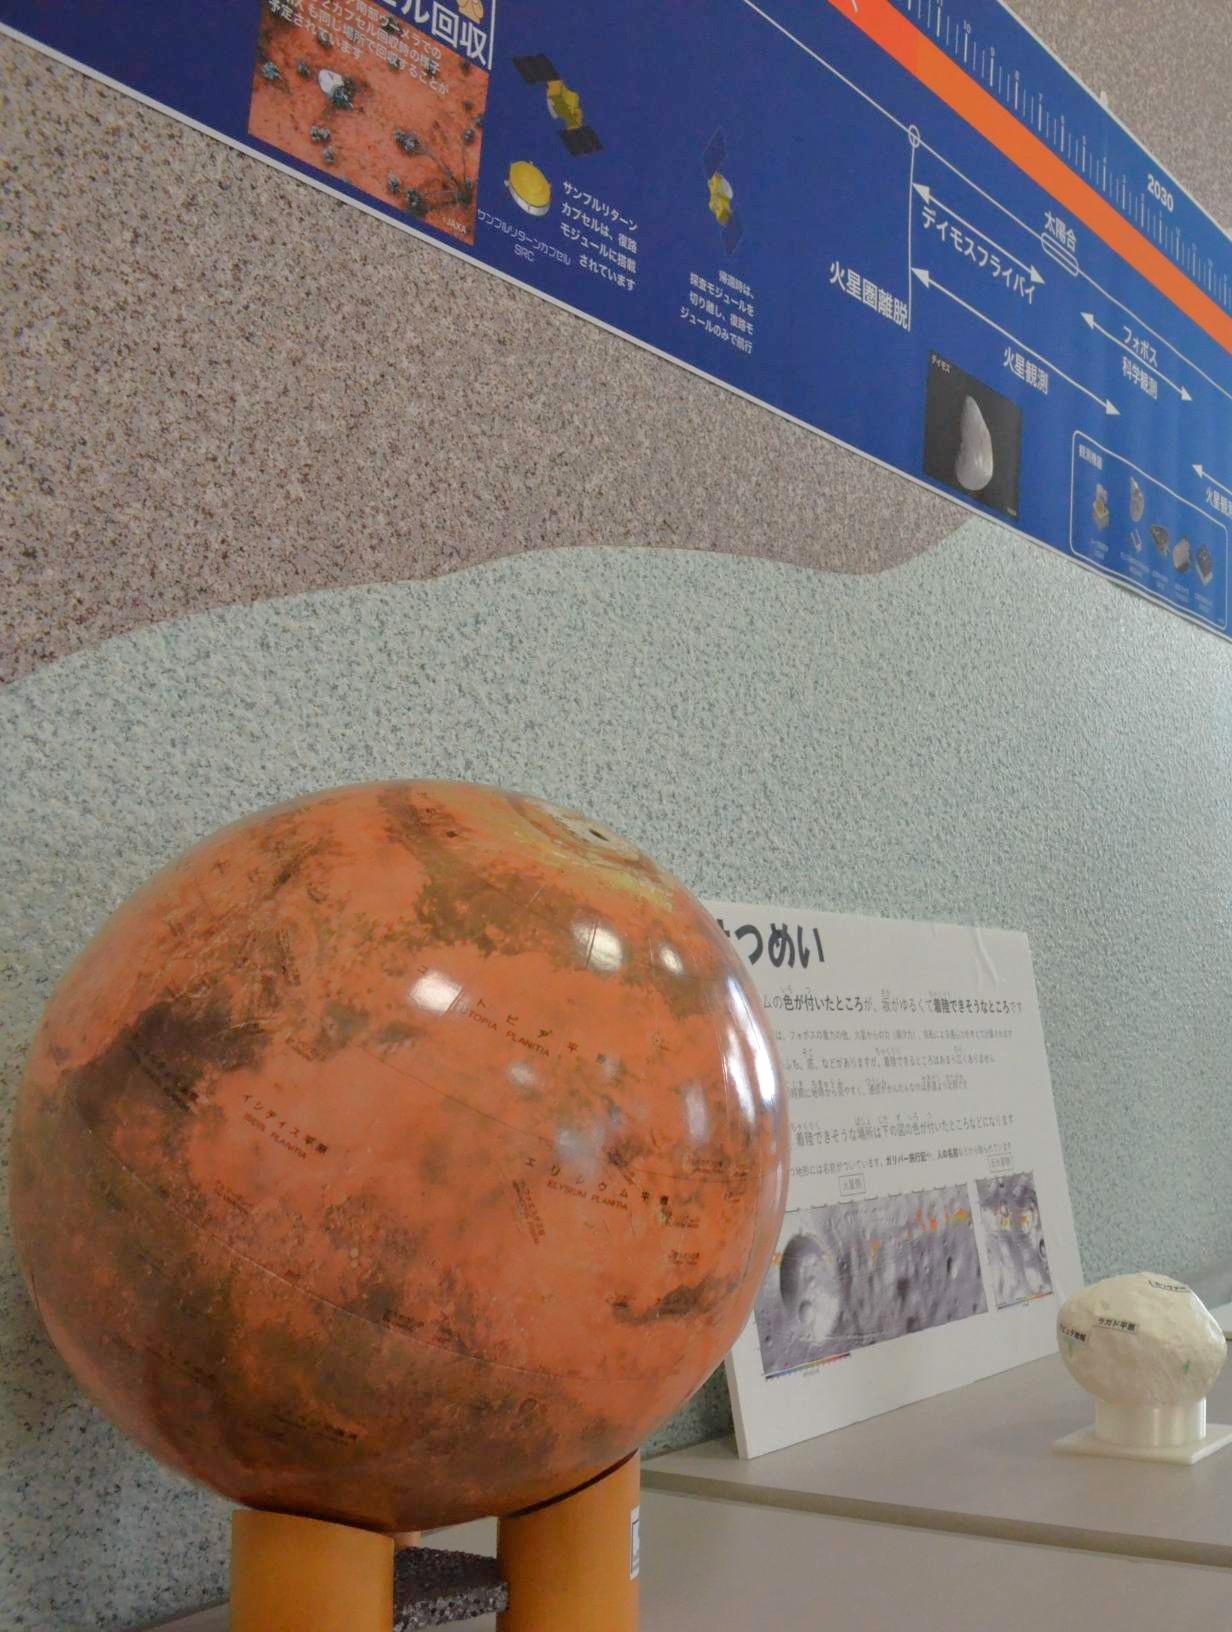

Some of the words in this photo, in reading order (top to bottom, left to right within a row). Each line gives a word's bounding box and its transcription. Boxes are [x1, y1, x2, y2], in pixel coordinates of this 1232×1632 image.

[381, 0, 488, 66] ル回収
[562, 180, 639, 232] サンプルリターン
[1147, 173, 1174, 213] 2030
[513, 243, 535, 263] SRC
[1043, 209, 1078, 255] 太陽合
[578, 253, 636, 292] されています
[920, 205, 1037, 306] ディモスフライバイ
[828, 260, 909, 331] 火星圏離脱
[1122, 325, 1158, 368] フォボス
[1003, 346, 1049, 396] 火星観測
[1121, 355, 1158, 401] 科学観測
[716, 918, 825, 969] つめい
[505, 1029, 550, 1057] PLANITIA
